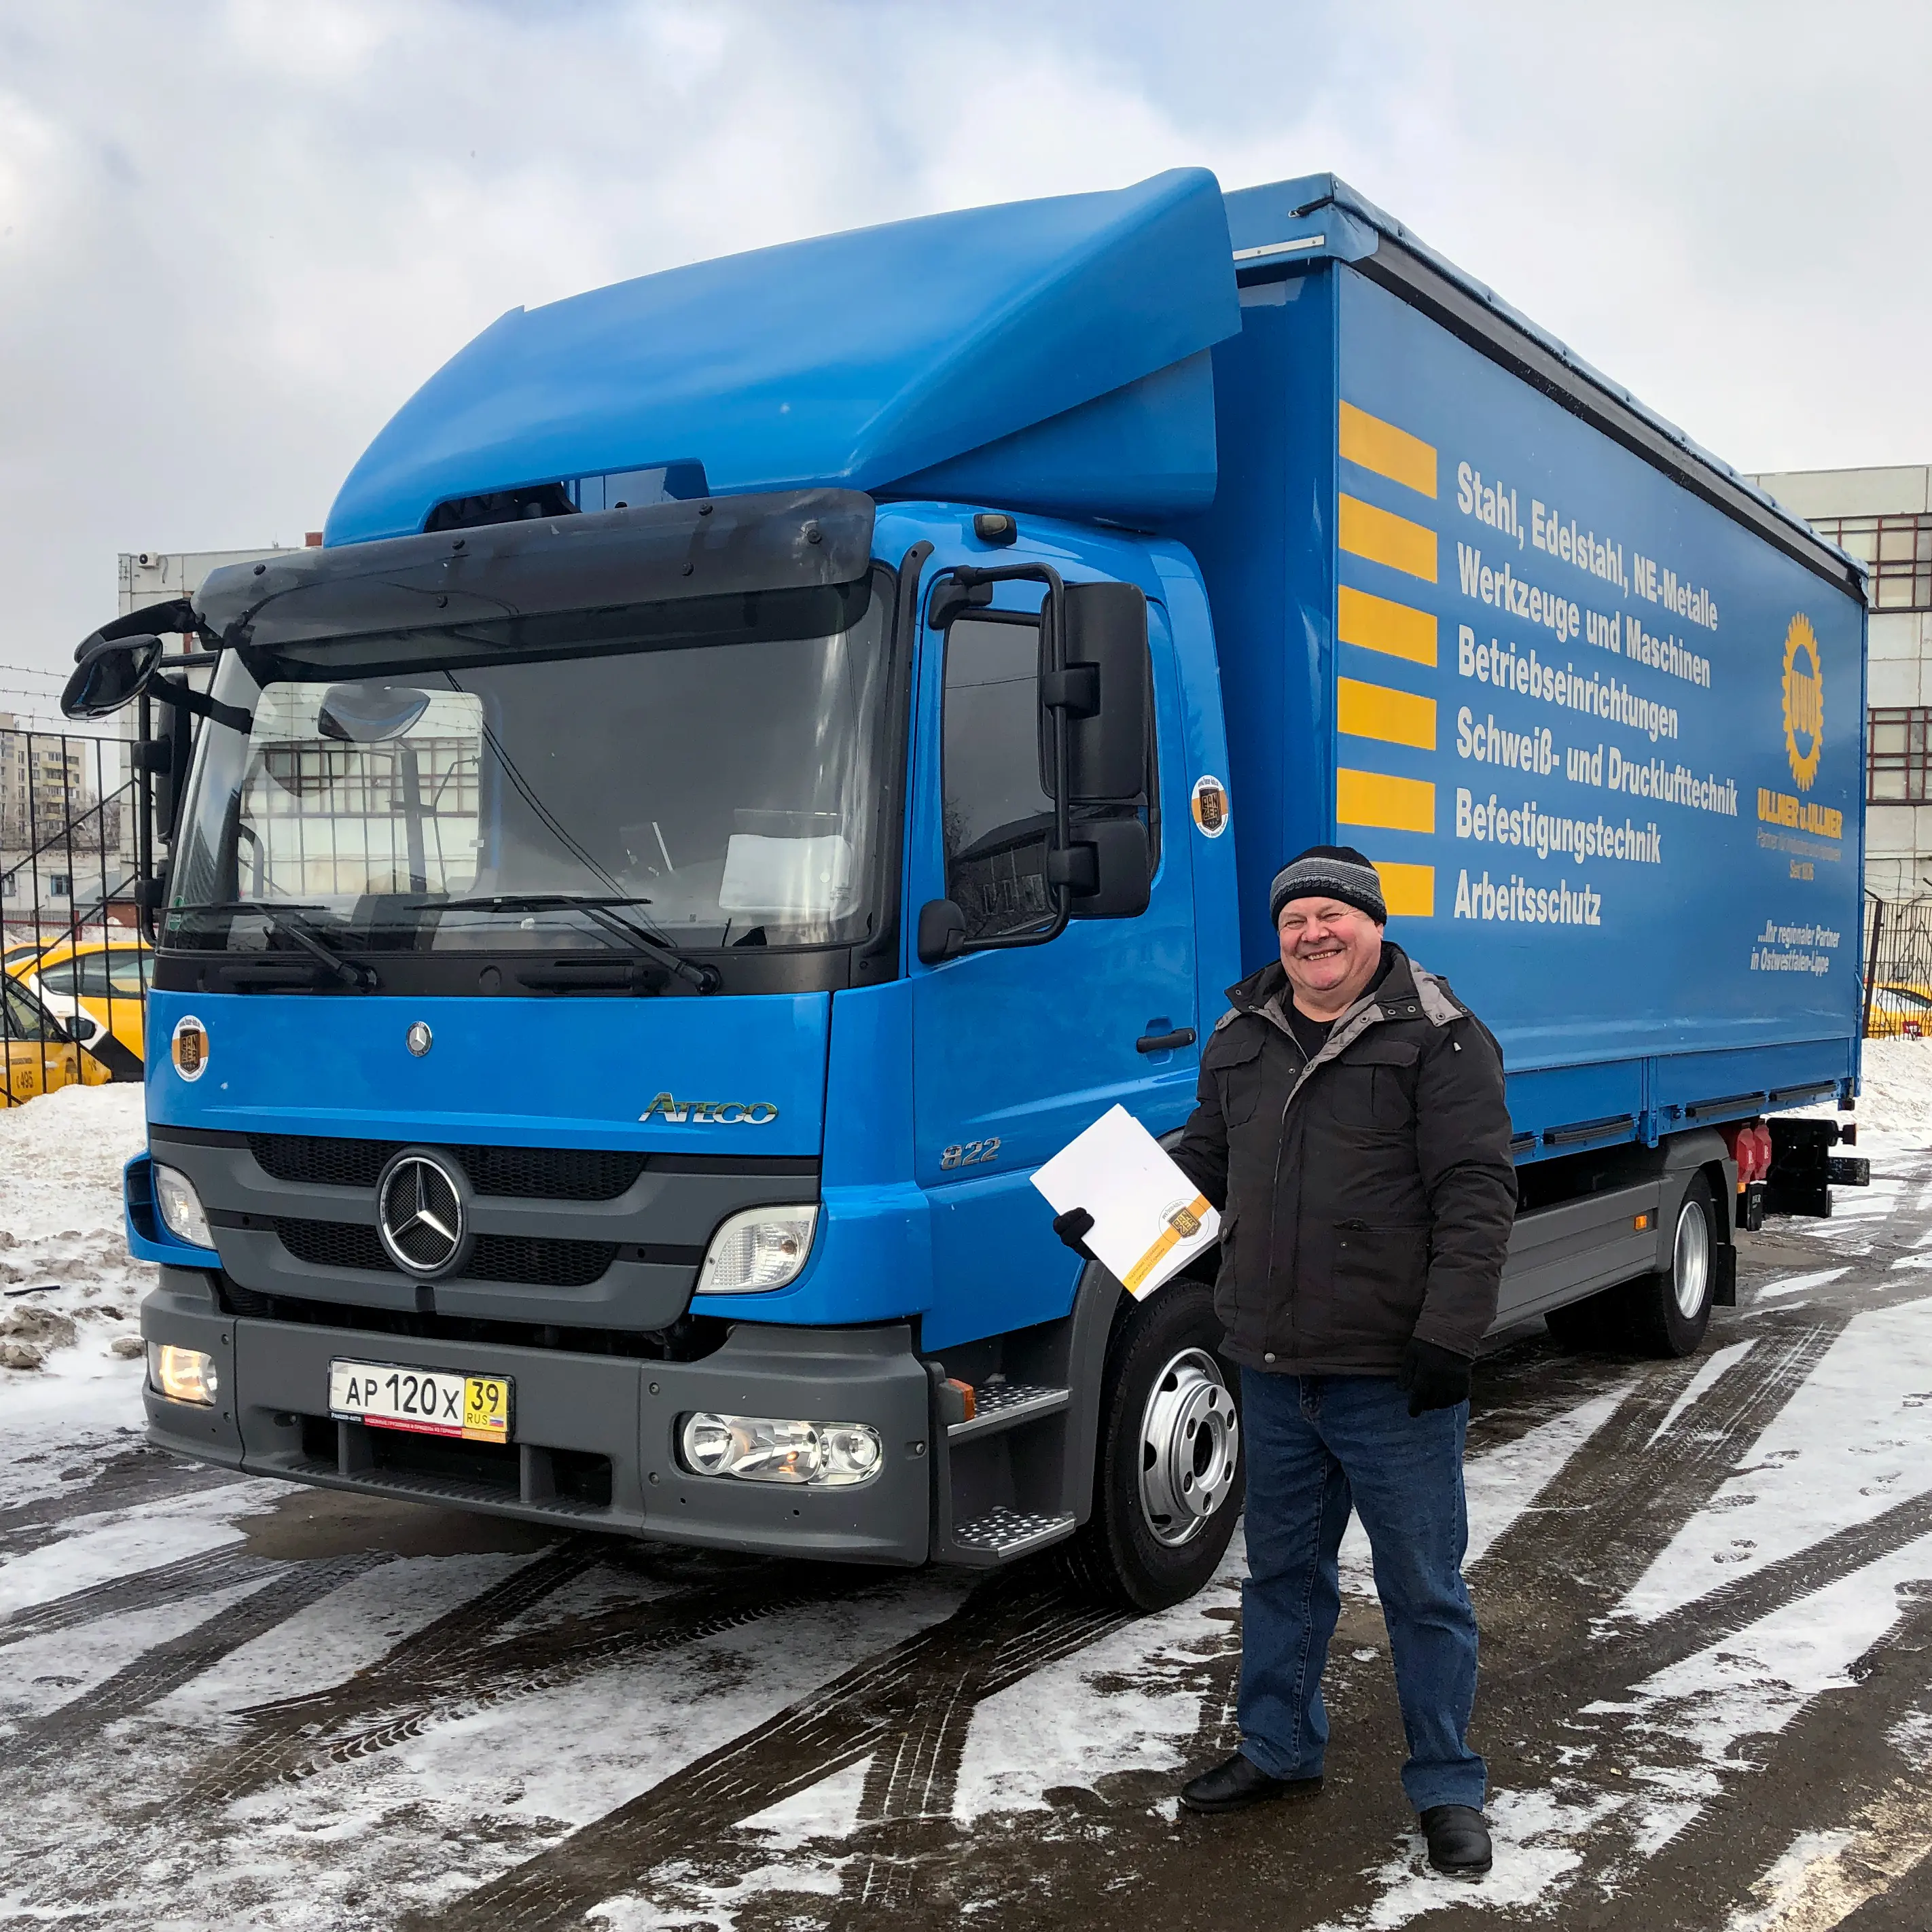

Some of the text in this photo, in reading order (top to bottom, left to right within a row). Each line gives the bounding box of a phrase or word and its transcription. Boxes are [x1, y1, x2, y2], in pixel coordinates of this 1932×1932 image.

[1456, 461, 1719, 630] Stahl, Edelstahl, NE-Metalle
[1457, 541, 1711, 688] Werkzeuge und Maschinen
[1459, 624, 1678, 742] Betriebseinrichtungen
[1456, 706, 1738, 817] Schweiß- und Drucklufttechnik
[1456, 787, 1662, 864] Befestigungstechnik
[1454, 869, 1601, 925] Arbeitsschutz
[1750, 946, 1829, 977] in Ostwestfalen-Lippe
[1778, 921, 1814, 948] regionaler
[1815, 924, 1840, 948] Partner
[941, 1137, 1001, 1170] 822
[467, 1412, 488, 1425] RUS
[471, 1381, 499, 1413] 39
